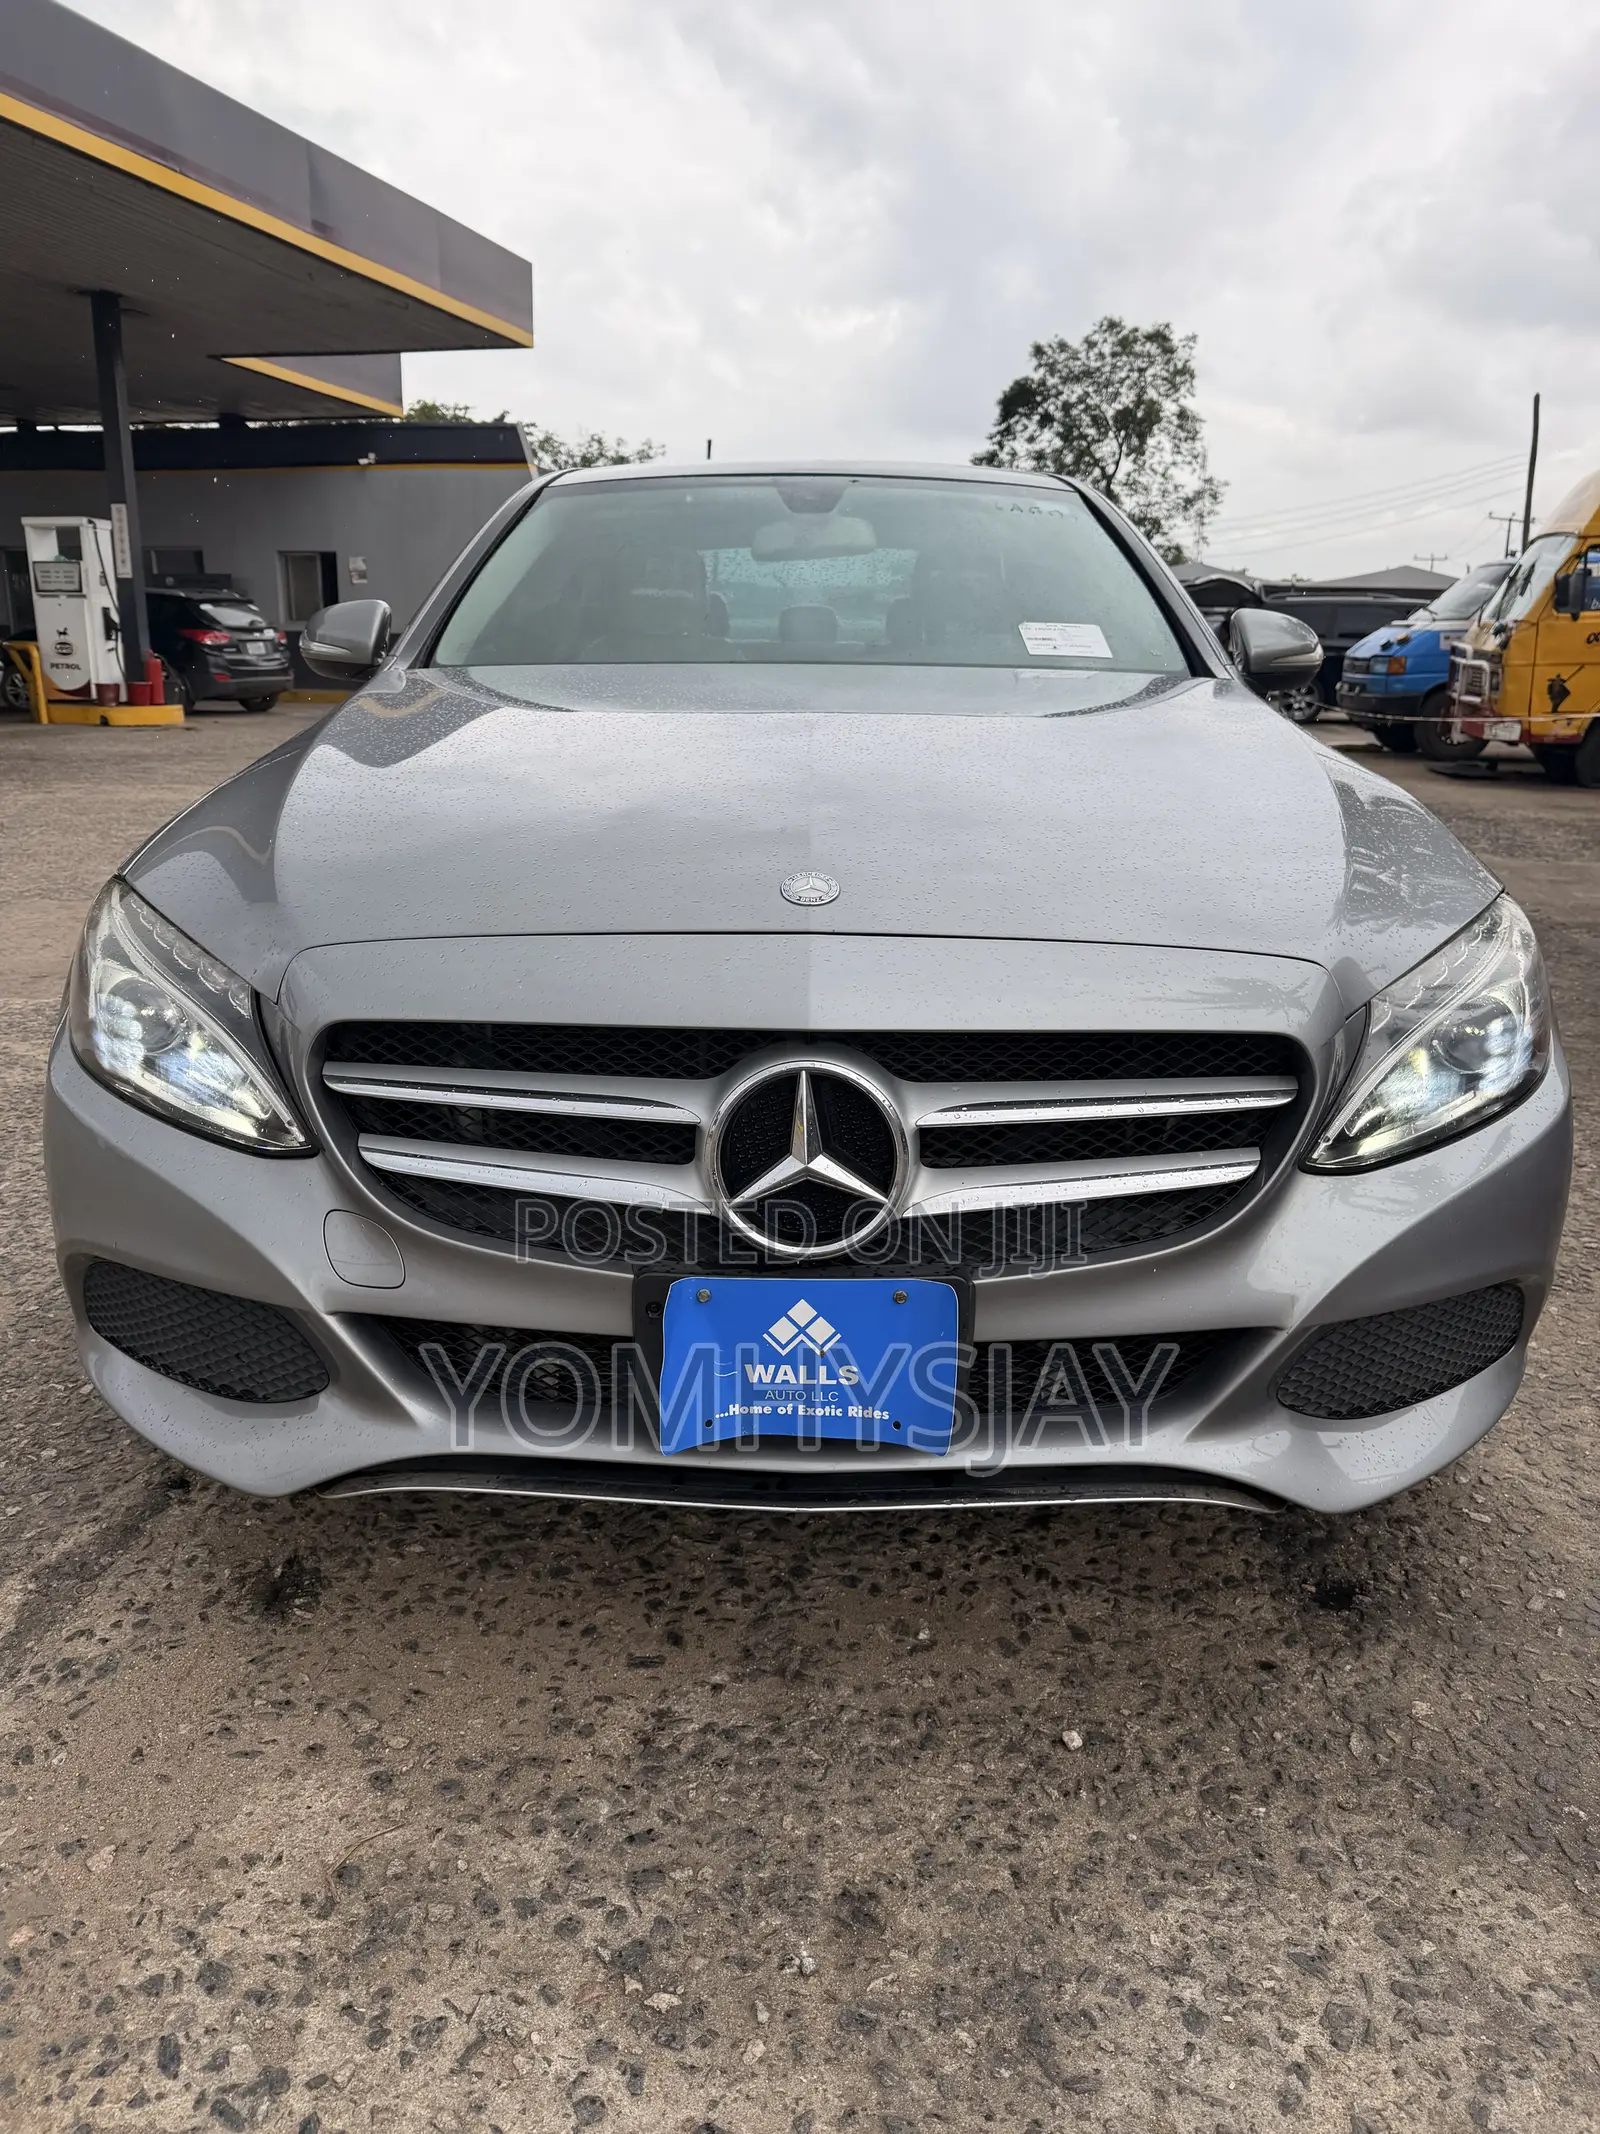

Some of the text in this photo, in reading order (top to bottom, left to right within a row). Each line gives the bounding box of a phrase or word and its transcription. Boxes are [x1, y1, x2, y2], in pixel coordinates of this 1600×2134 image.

[49, 662, 82, 671] PETROL
[744, 1363, 859, 1386] WALLS
[764, 1390, 839, 1402] AUTO LLC
[777, 1403, 793, 1415] of
[797, 1404, 843, 1417] Exotic
[847, 1405, 890, 1420] Rides
